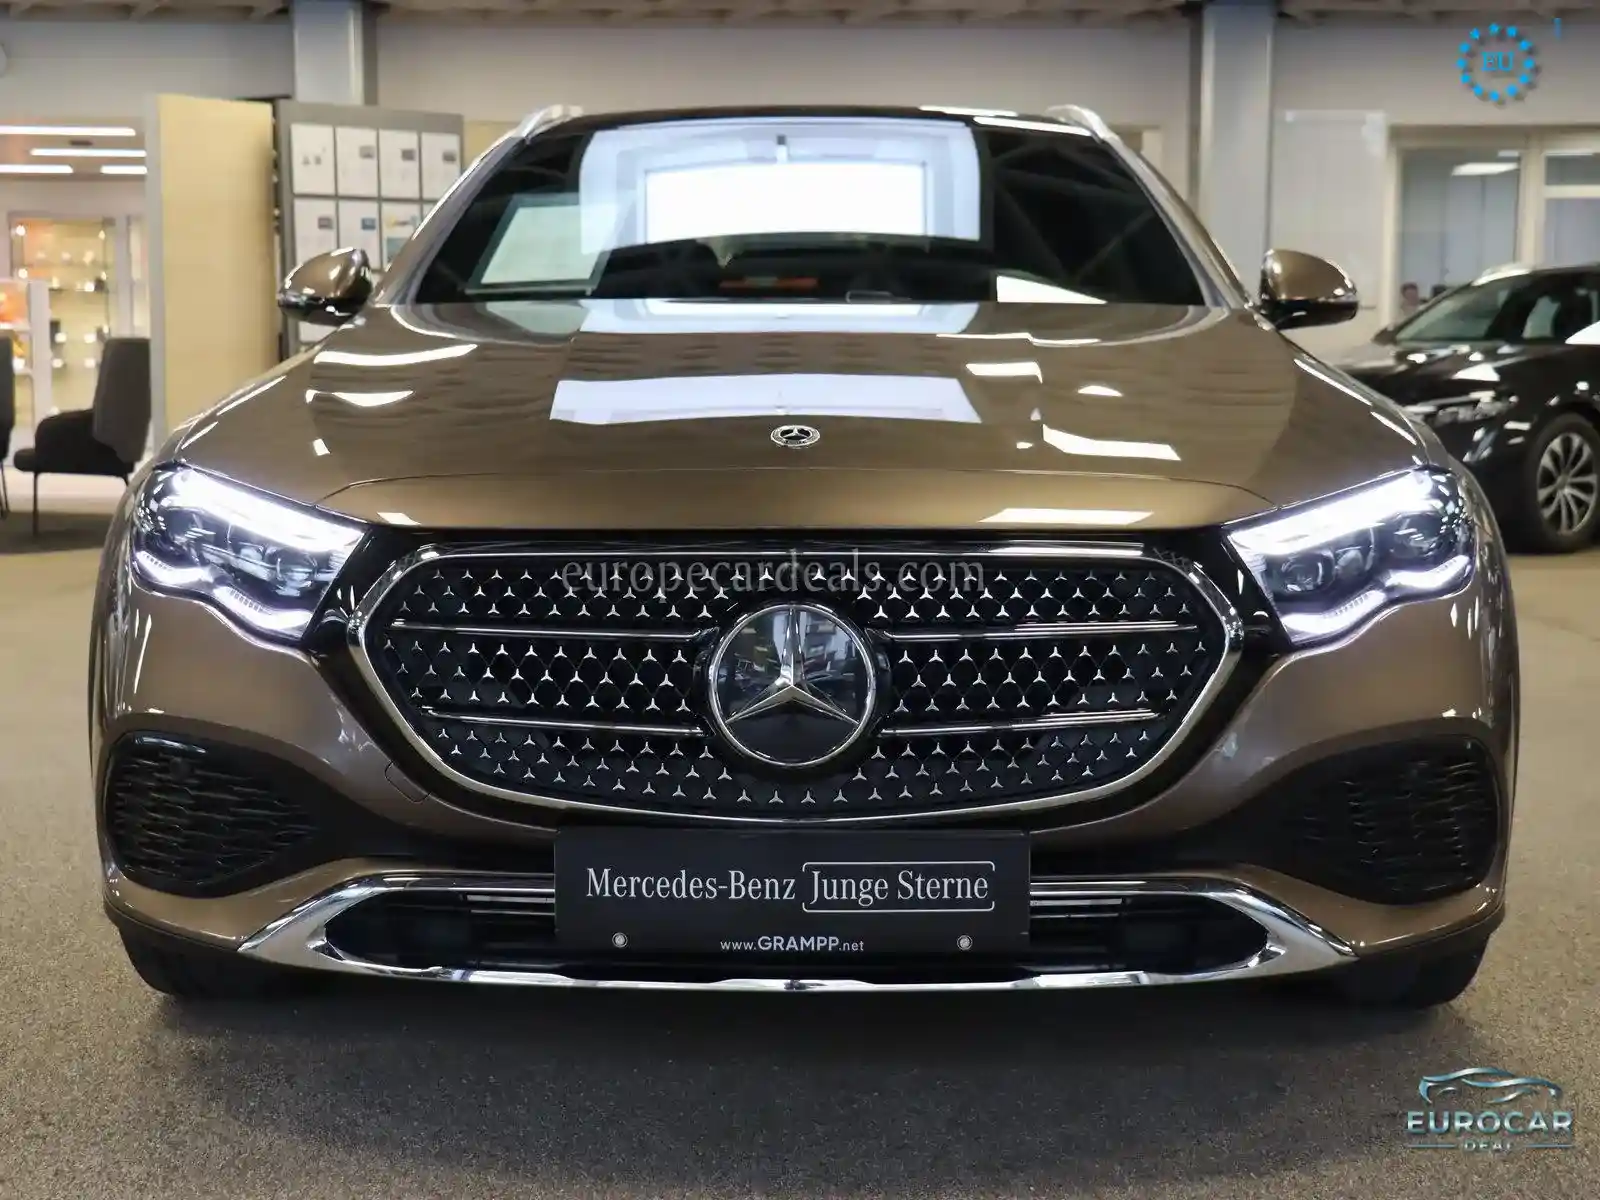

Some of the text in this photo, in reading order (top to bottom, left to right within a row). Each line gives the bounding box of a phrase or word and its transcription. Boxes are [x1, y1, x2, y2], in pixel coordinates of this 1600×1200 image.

[586, 867, 989, 907] Mercedes-Benz Junge Sterne
[719, 935, 865, 953] www.GRAMPP.net
